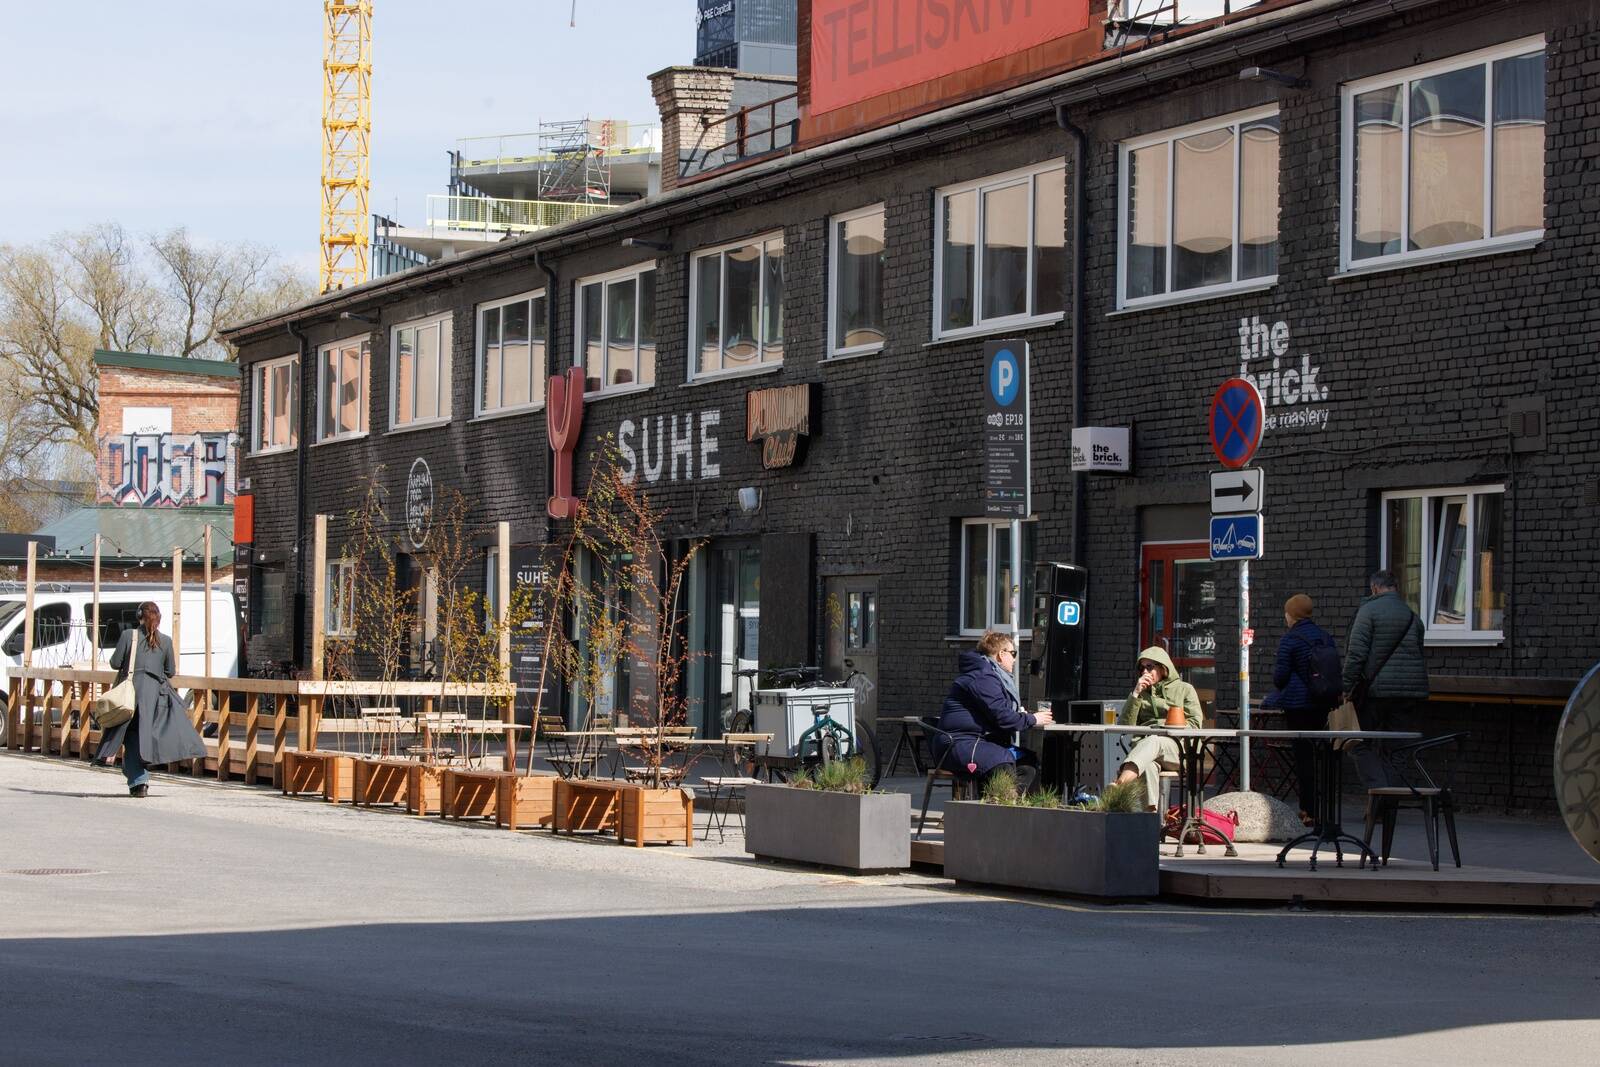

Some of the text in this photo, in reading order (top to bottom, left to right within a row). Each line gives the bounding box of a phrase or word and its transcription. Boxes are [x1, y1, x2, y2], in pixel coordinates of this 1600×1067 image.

[824, 0, 1032, 82] TELLISK
[1238, 315, 1290, 360] the
[998, 360, 1013, 396] P
[1005, 413, 1023, 426] EP18
[1279, 407, 1329, 430] roastery
[619, 410, 720, 485] SUHE
[1092, 444, 1110, 453] the
[1092, 452, 1123, 462] brick.
[517, 571, 549, 584] SUHE
[1064, 605, 1075, 621] P
